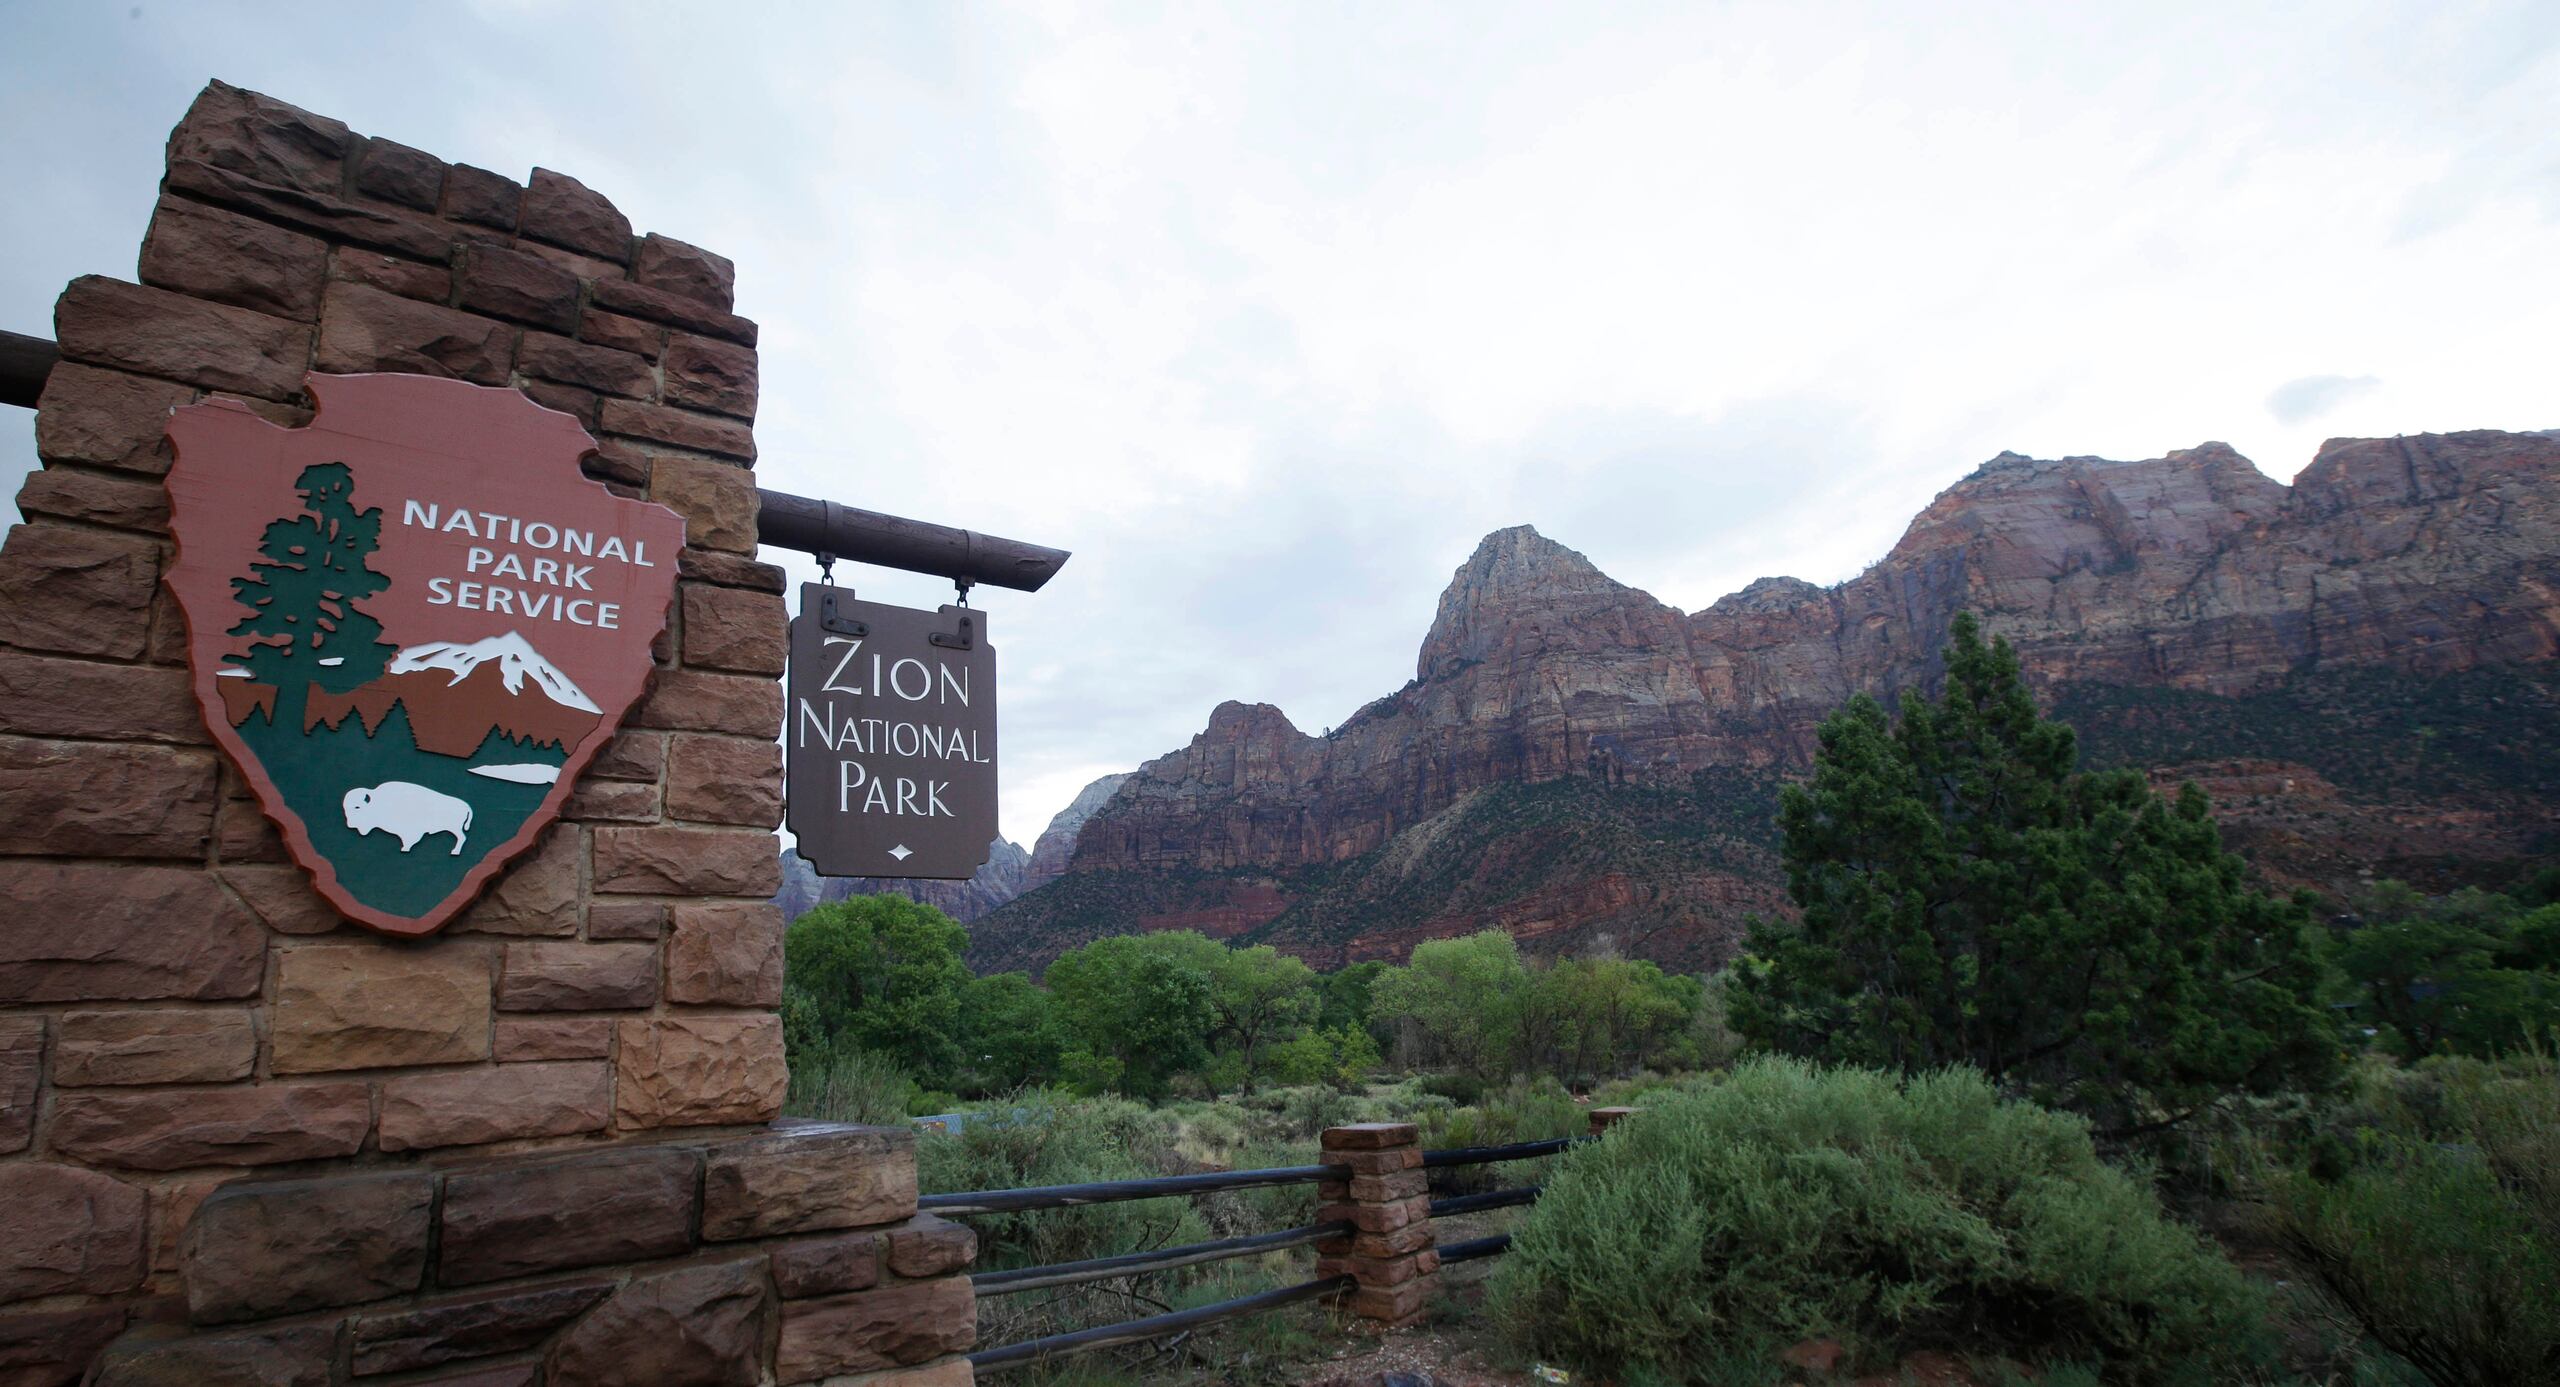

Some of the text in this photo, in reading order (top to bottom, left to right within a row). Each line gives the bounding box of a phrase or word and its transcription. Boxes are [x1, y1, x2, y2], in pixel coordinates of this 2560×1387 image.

[403, 499, 655, 567] NATIONAL
[467, 547, 594, 591] PARK
[427, 577, 620, 629] SERVICE
[821, 636, 968, 707] ZION
[800, 697, 990, 763] NATIONAL
[839, 760, 956, 817] PARK
